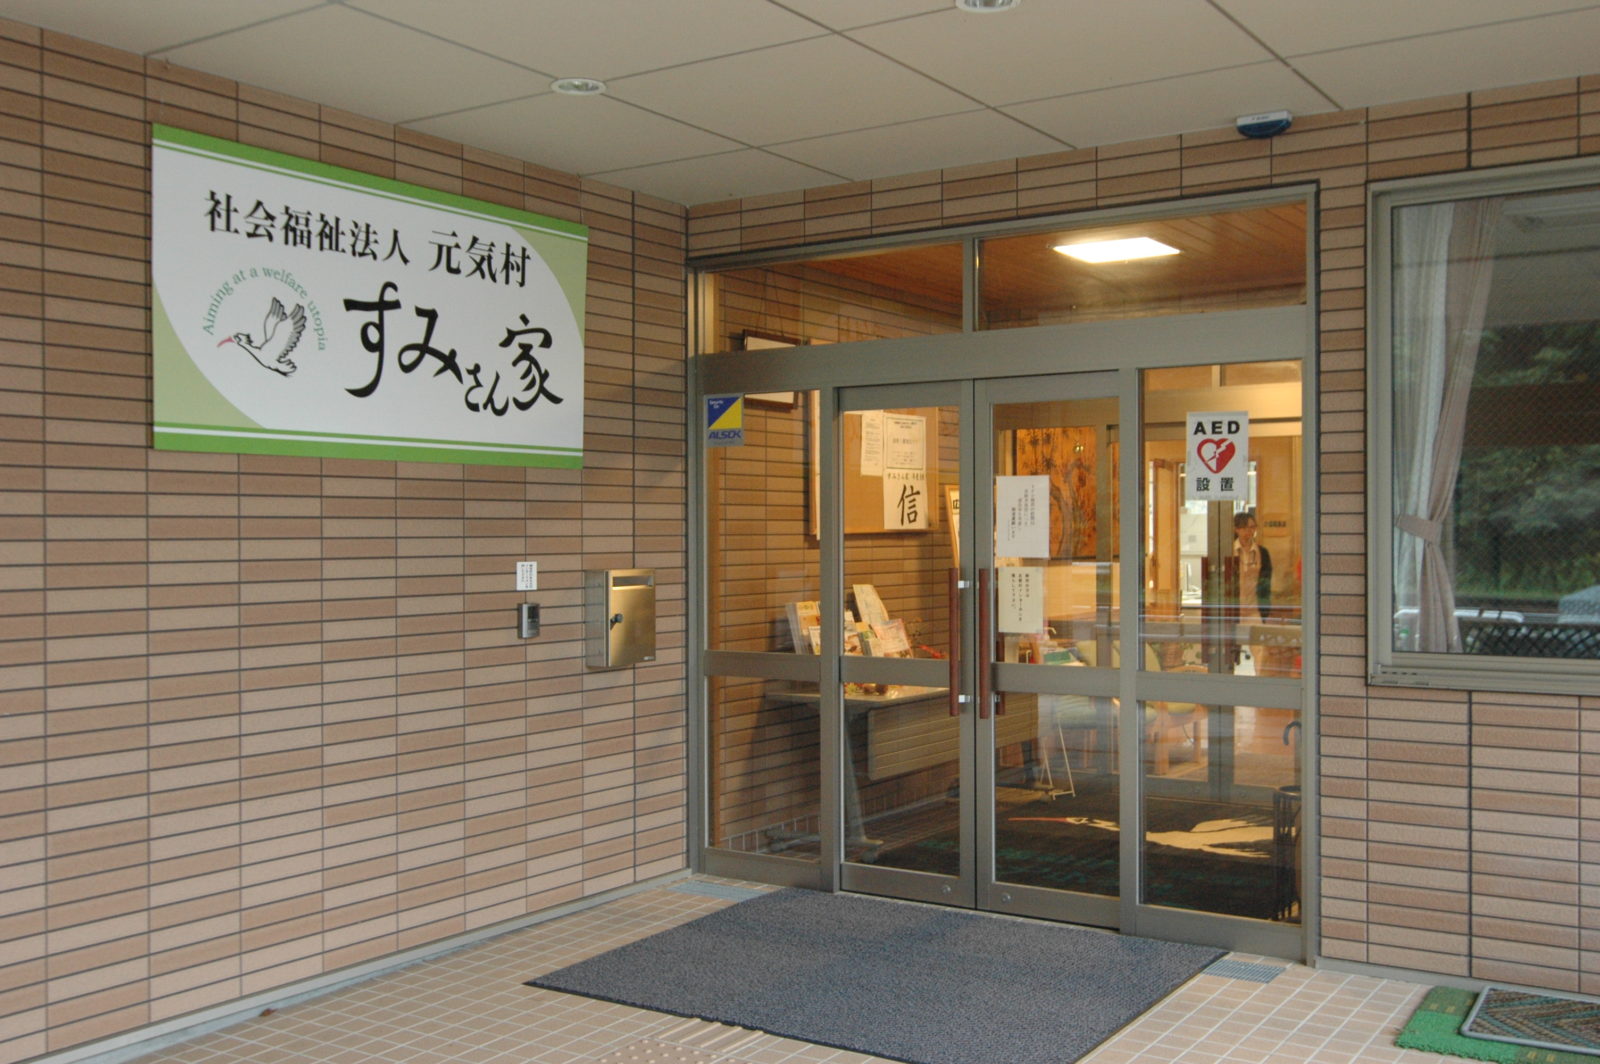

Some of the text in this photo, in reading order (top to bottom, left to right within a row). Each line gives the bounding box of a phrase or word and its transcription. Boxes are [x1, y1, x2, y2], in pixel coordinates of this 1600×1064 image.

[204, 190, 531, 287] 社会福祉法人 元気村
[203, 266, 328, 351] Aiming at a welfare utopia
[343, 281, 564, 417] すみさん家
[708, 430, 742, 440] ALSOK
[1193, 421, 1240, 435] AED
[897, 484, 921, 527] 信
[1196, 477, 1234, 492] 設置
